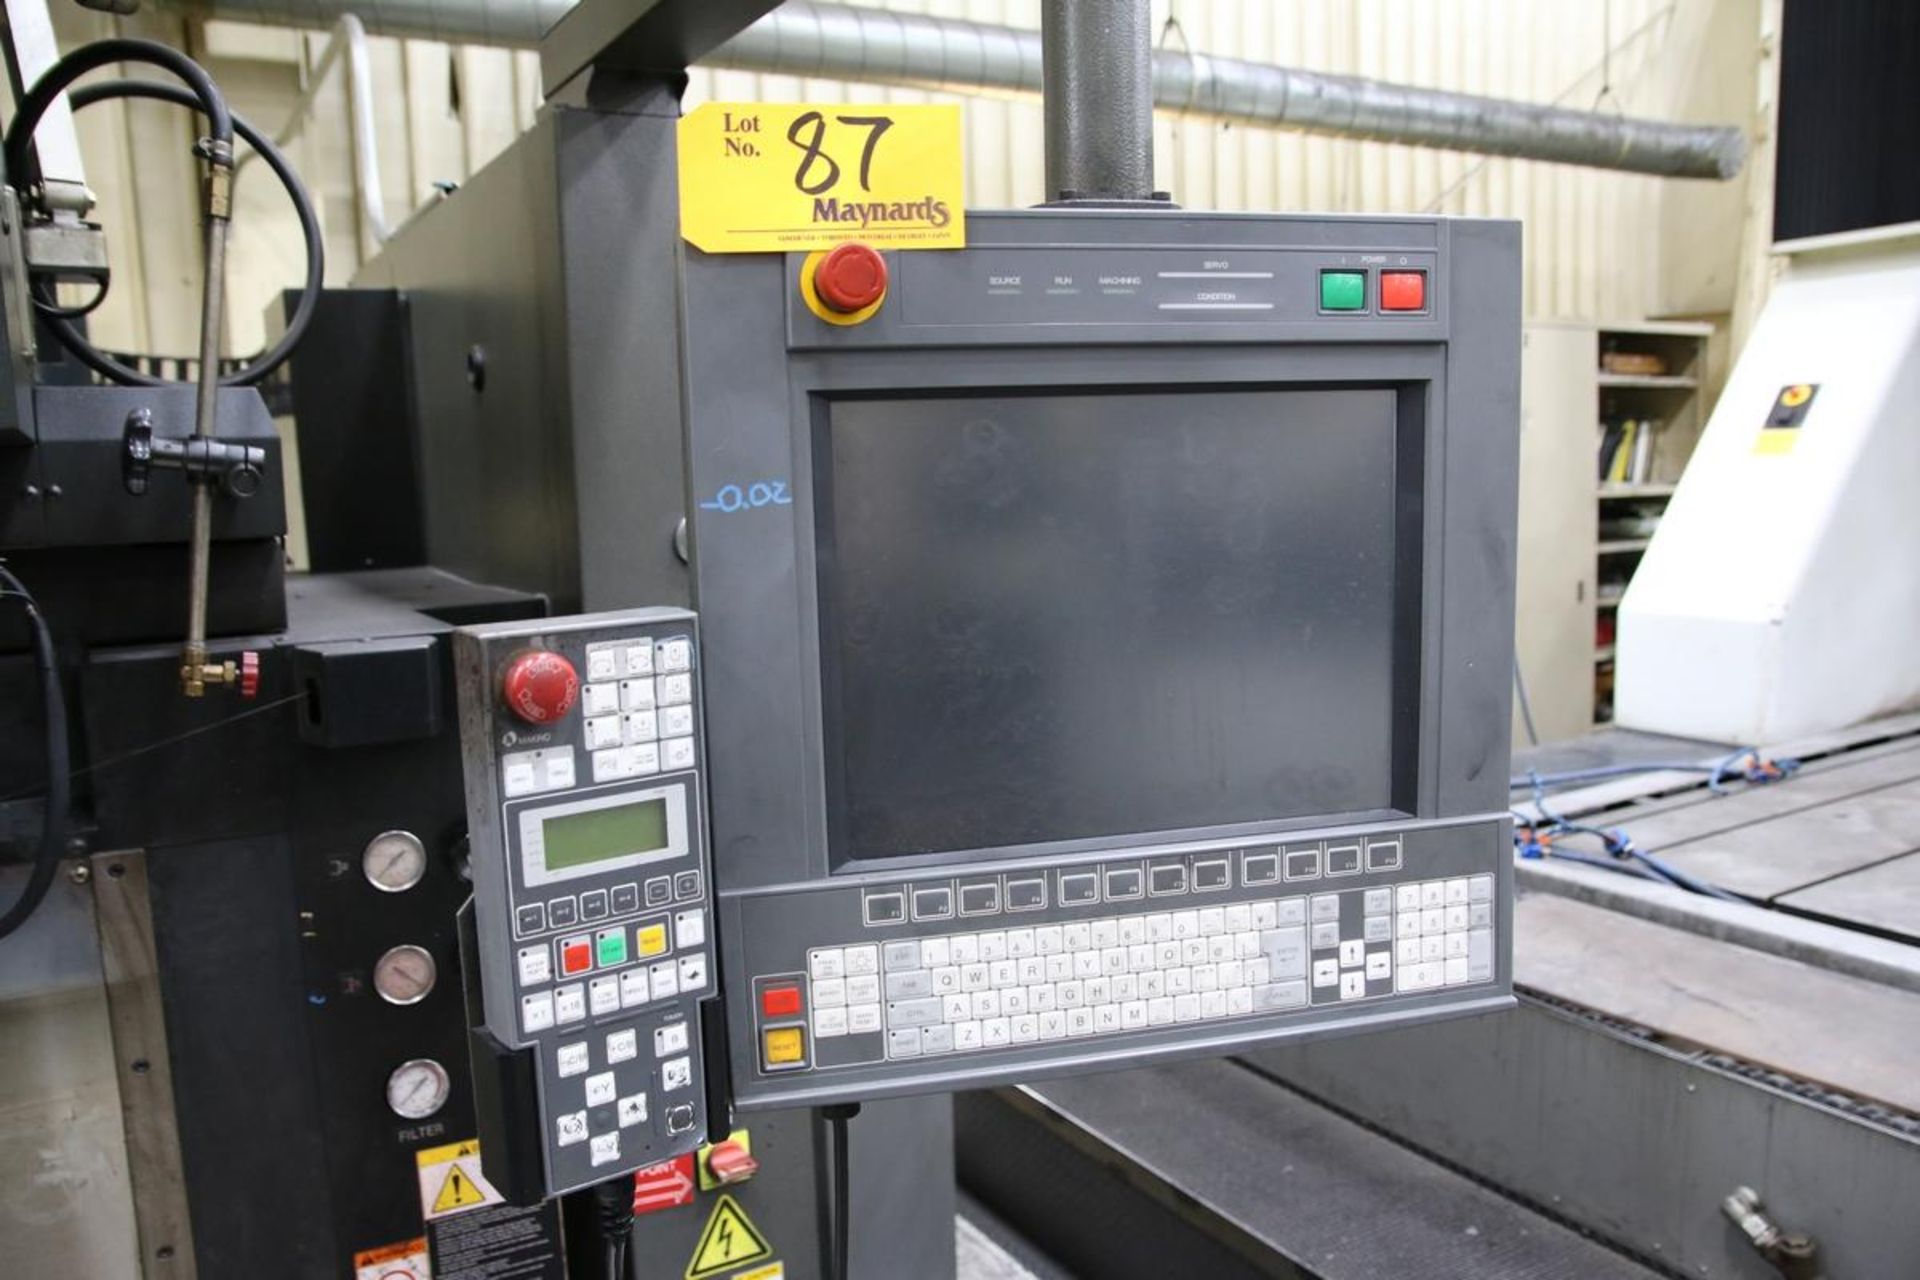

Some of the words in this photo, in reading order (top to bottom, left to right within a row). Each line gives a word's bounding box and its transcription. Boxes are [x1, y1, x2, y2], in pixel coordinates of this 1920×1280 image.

[723, 112, 760, 133] Lot
[724, 138, 761, 158] No.
[787, 111, 895, 195] 87
[812, 197, 951, 229] Maynards
[1203, 261, 1228, 269] SERVO
[989, 276, 1022, 285] SOURCE
[1055, 276, 1072, 285] RUN
[1197, 292, 1236, 301] CONDITION
[941, 975, 952, 986] Q
[969, 972, 982, 982] W
[1000, 969, 1008, 980] E
[1028, 965, 1037, 976] R
[1055, 962, 1064, 974] T
[1083, 959, 1091, 969] Y
[1111, 956, 1119, 967] U
[1191, 946, 1200, 956] P
[954, 1003, 962, 1013] A
[982, 999, 990, 1010] S
[1010, 996, 1019, 1007] D
[1038, 992, 1046, 1002] F
[1065, 989, 1074, 1000] G
[1093, 986, 1102, 996] H
[1120, 983, 1128, 993] J
[1148, 979, 1157, 989] K
[1176, 976, 1182, 986] L
[964, 1029, 972, 1041] Z
[992, 1027, 1001, 1037] X
[1020, 1023, 1029, 1033] C
[1048, 1019, 1057, 1030] V
[1076, 1016, 1085, 1026] B
[1103, 1013, 1112, 1023] N
[1129, 1009, 1139, 1019] M
[398, 1122, 444, 1143] FILTER
